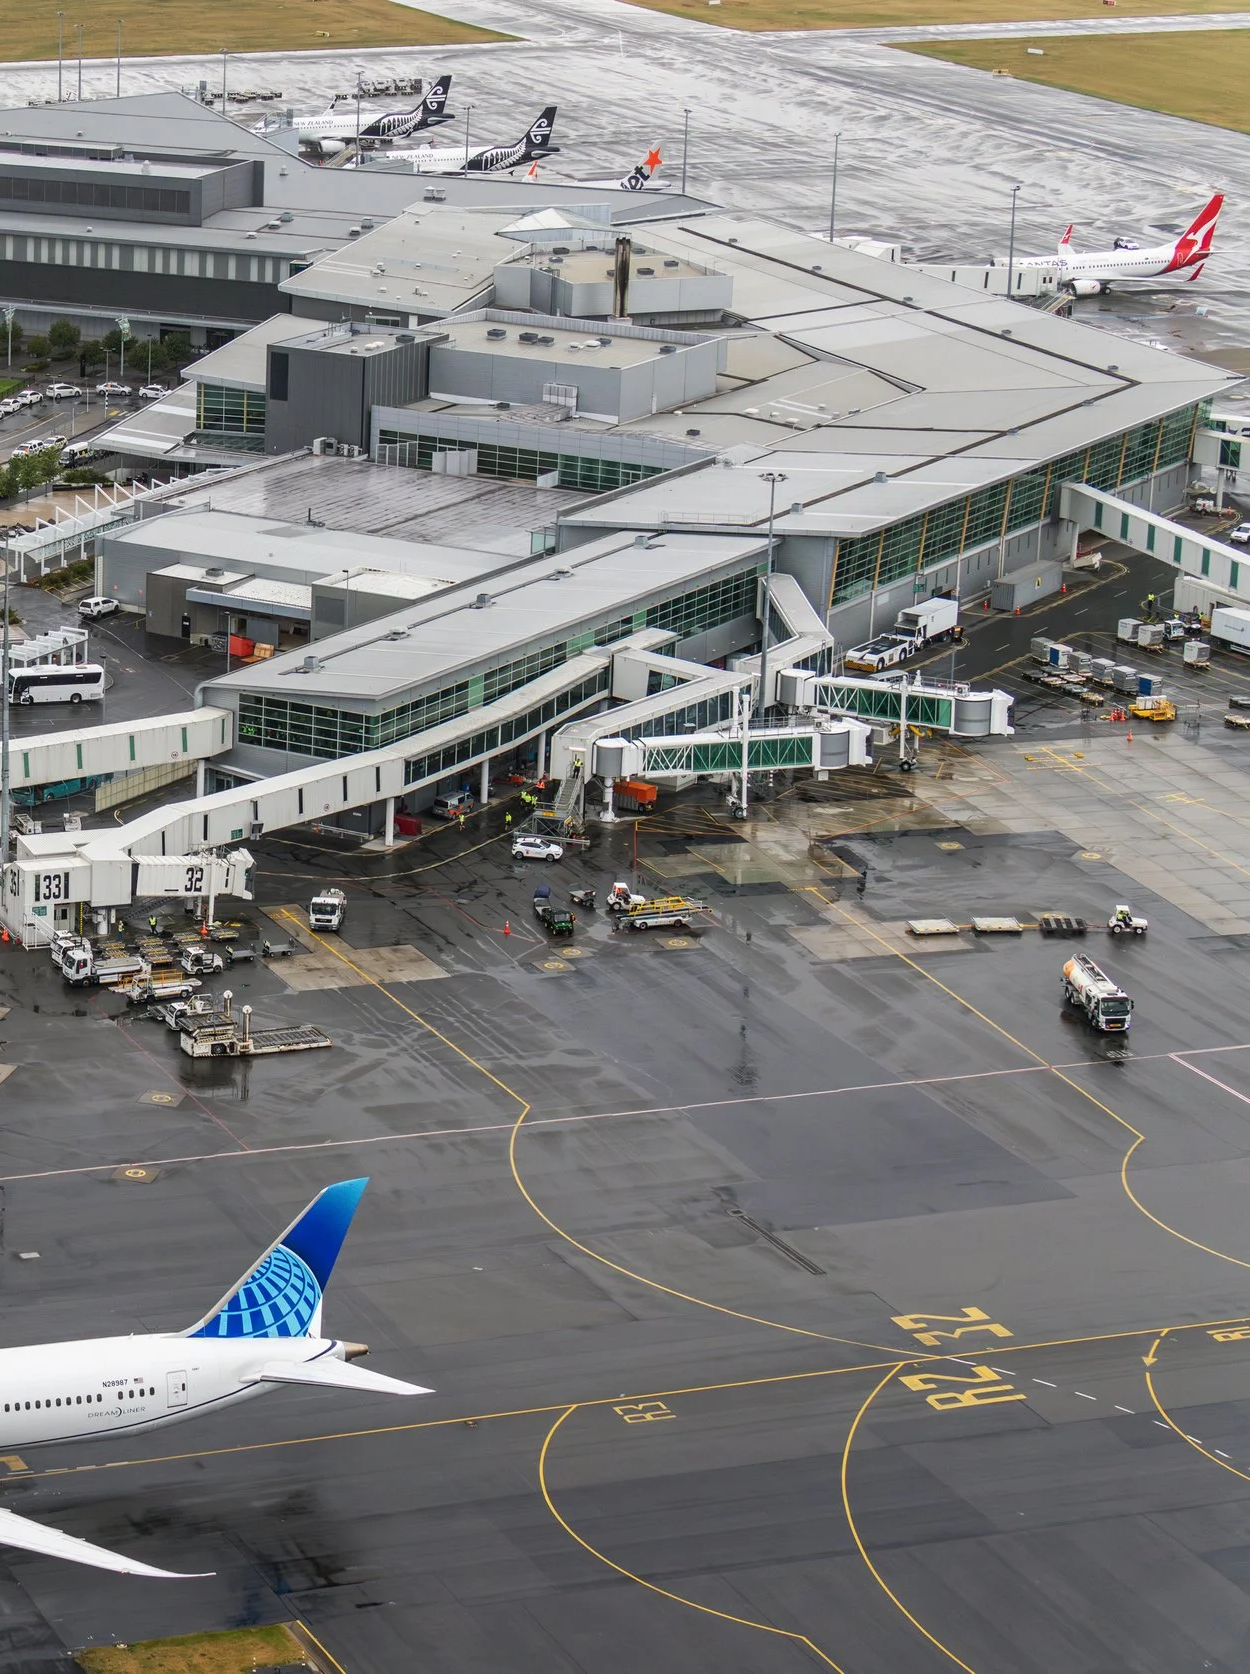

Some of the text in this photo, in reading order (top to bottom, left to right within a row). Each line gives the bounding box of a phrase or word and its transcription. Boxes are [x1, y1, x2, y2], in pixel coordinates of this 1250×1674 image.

[43, 874, 62, 900] 33
[184, 867, 204, 893] 32
[890, 1306, 1015, 1346] 32
[102, 1379, 128, 1388] N28987
[897, 1365, 1028, 1411] R2
[87, 1406, 147, 1418] DREAMLINER
[613, 1401, 678, 1424] R3
